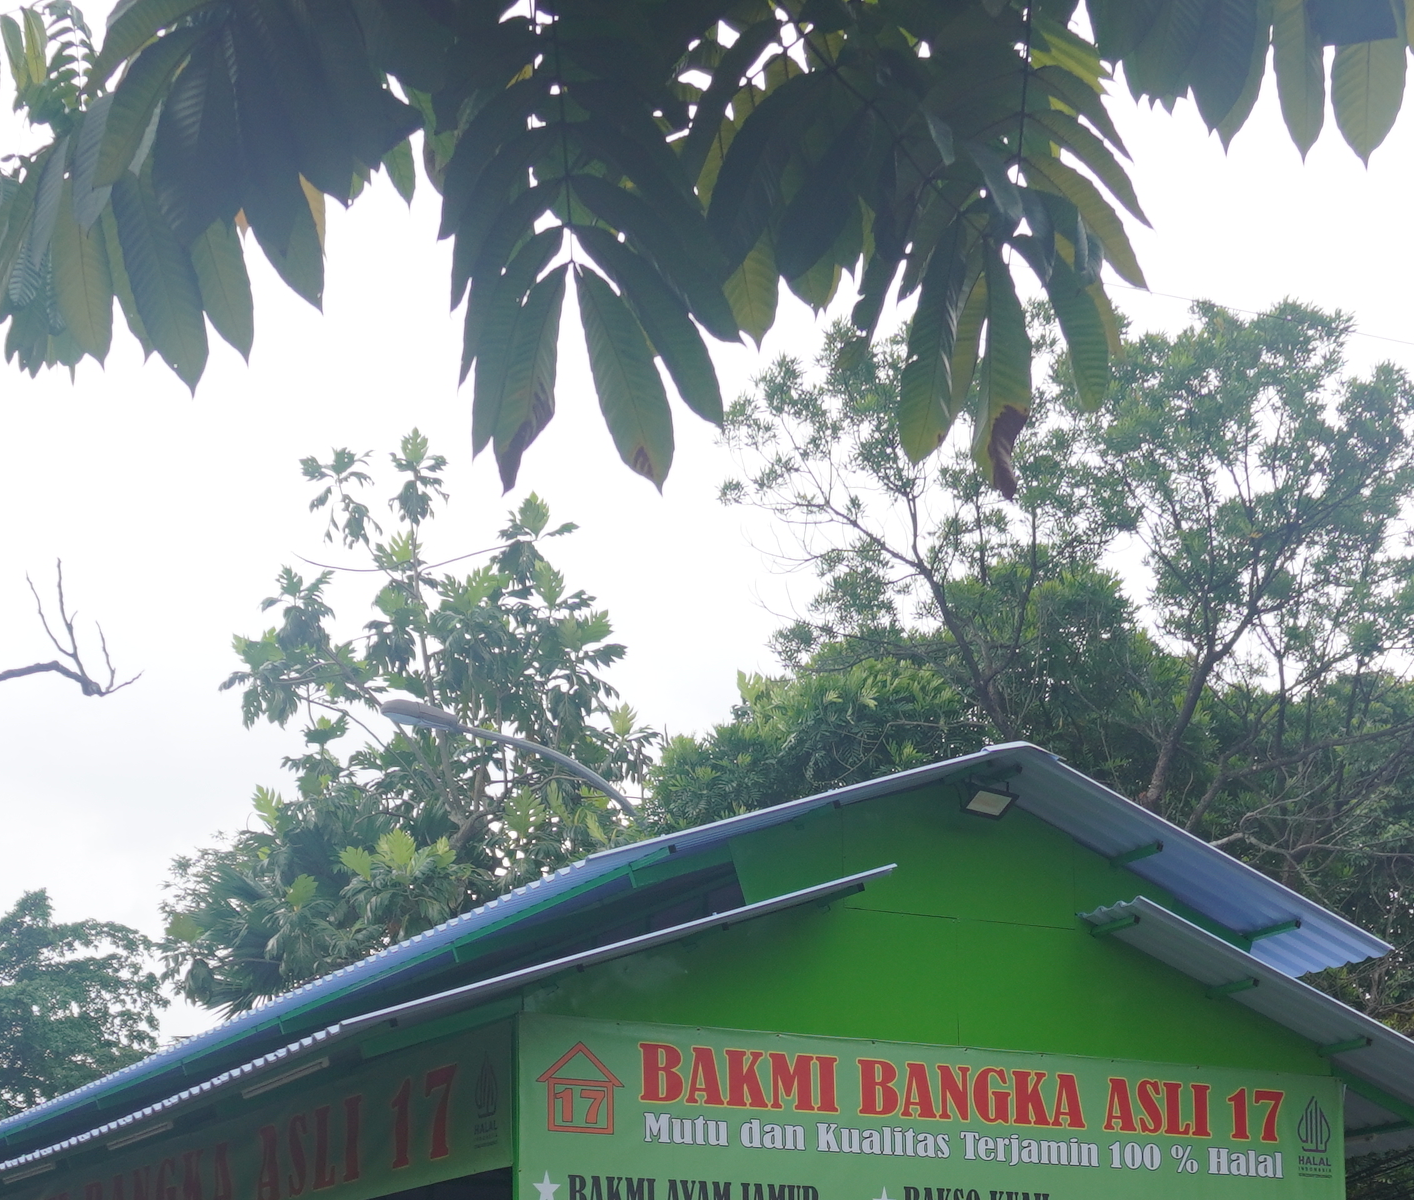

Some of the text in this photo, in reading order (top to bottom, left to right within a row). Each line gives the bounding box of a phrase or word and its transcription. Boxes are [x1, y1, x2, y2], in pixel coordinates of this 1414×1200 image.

[391, 1062, 457, 1169] 17
[554, 1088, 606, 1124] 17
[638, 1041, 1285, 1143] BAKMI BANGKA ASLI 17
[643, 1112, 1285, 1179] Mutu dan Kualitas Terjamin 100 % Halal
[1298, 1155, 1332, 1167] HALAL
